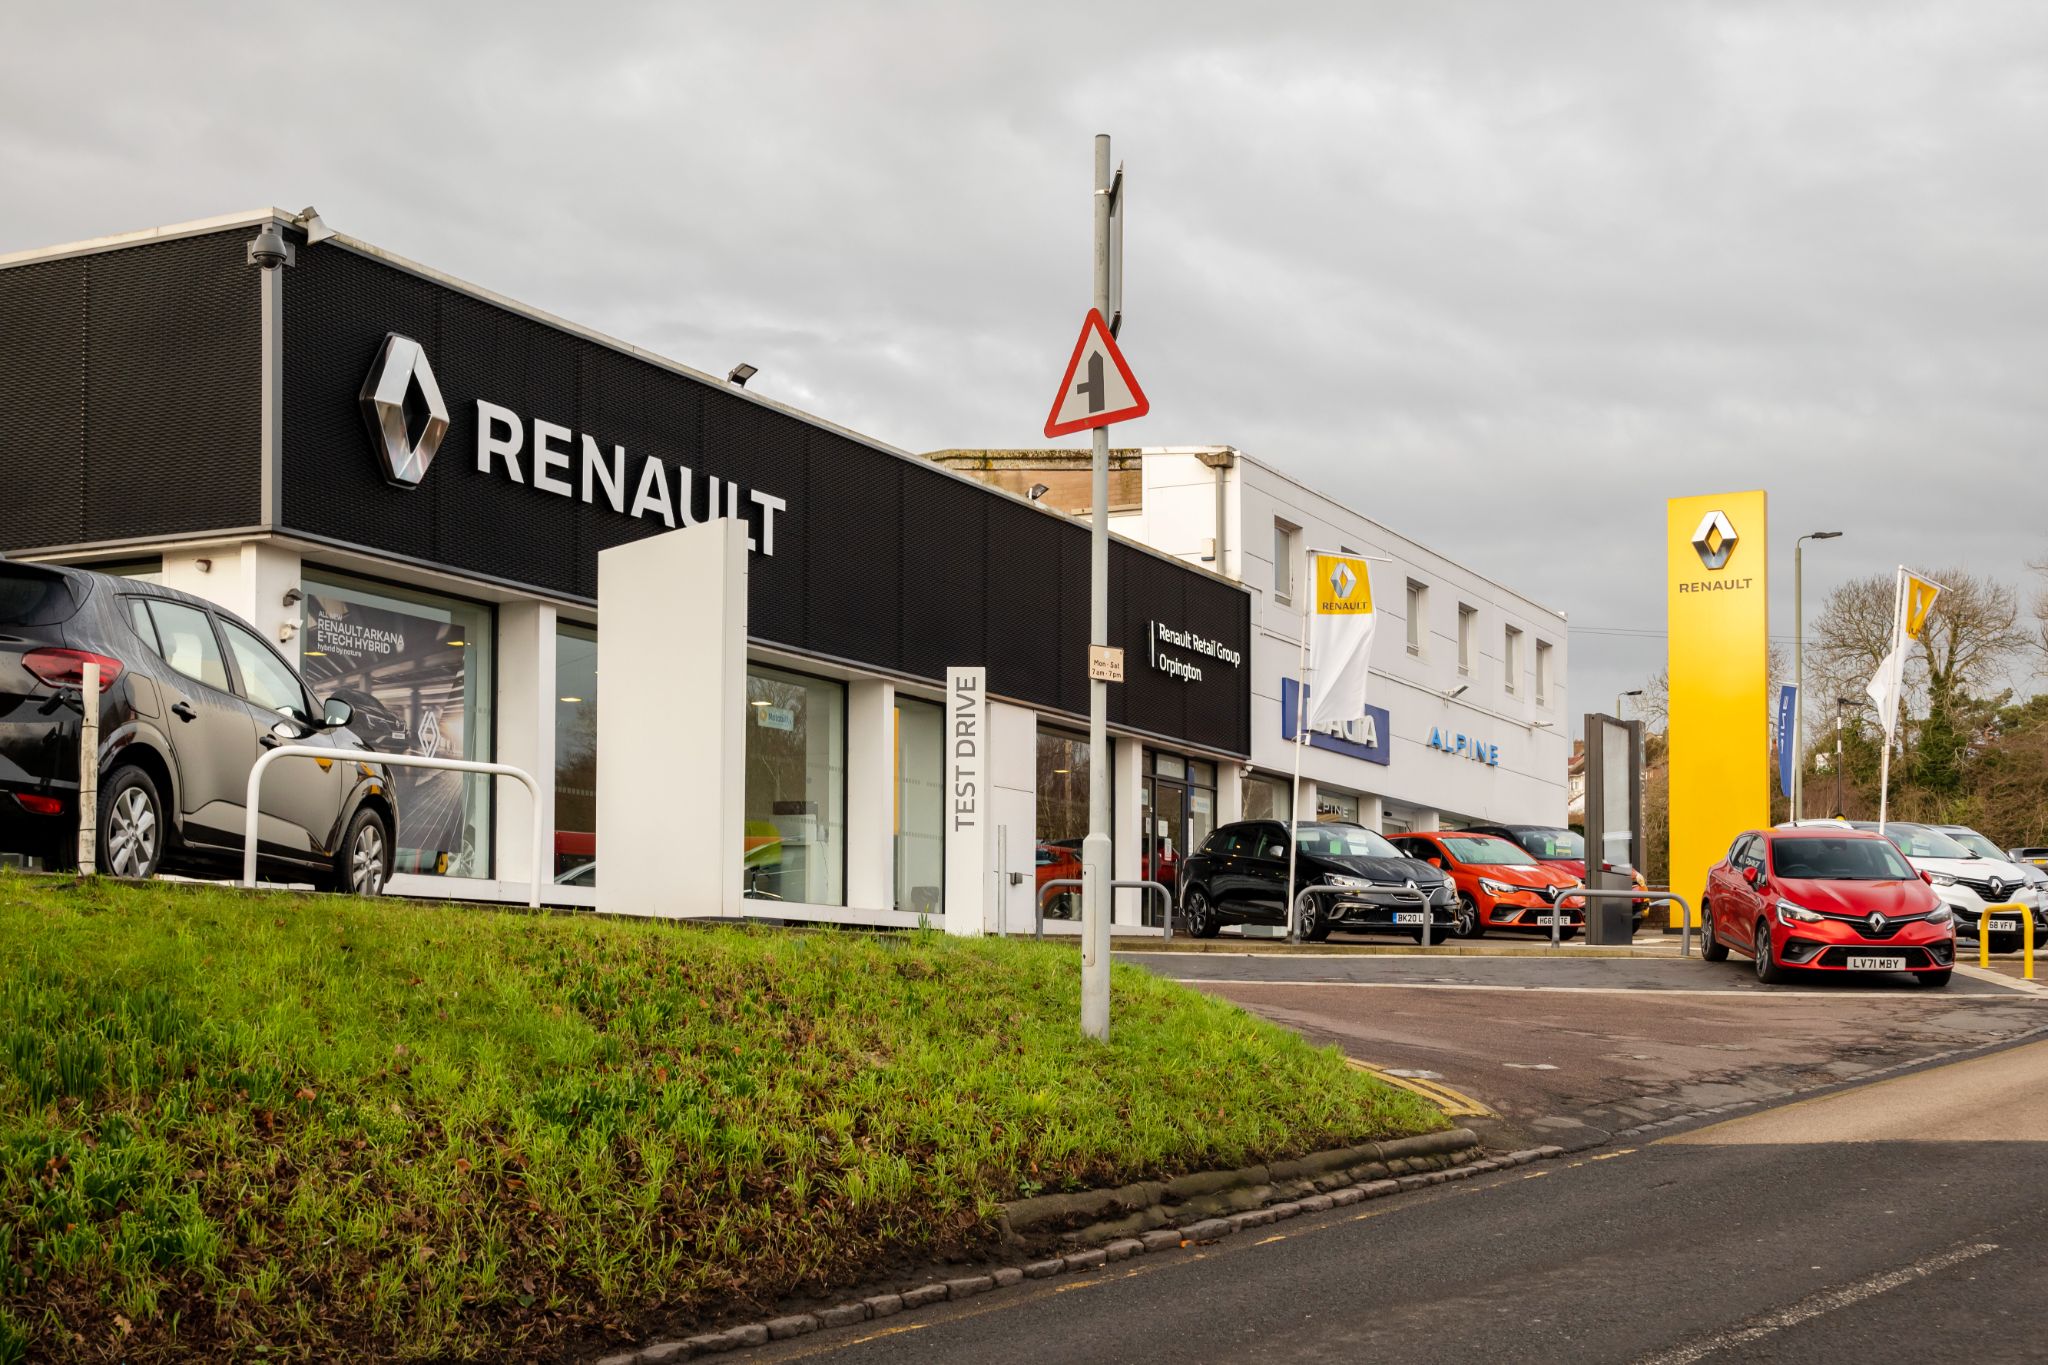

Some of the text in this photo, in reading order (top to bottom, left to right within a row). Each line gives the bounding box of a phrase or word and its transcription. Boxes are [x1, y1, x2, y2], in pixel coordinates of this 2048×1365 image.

[477, 399, 786, 556] RENAULT
[1679, 578, 1752, 593] RENAULT
[1322, 601, 1368, 611] RENAULT
[317, 618, 404, 645] RENAULT ARKANA
[317, 630, 391, 654] E-TECH HYBRID
[317, 643, 336, 653] hybrid
[343, 648, 362, 658] nature
[1159, 622, 1240, 669] Renault Retail Group
[1159, 653, 1202, 682] Orpington
[955, 676, 977, 832] TEST DRIVE
[1427, 726, 1499, 766] ALPINE
[1397, 914, 1417, 923] BK20
[1539, 917, 1553, 925] HG6
[1853, 958, 1899, 969] LV71 MBY
